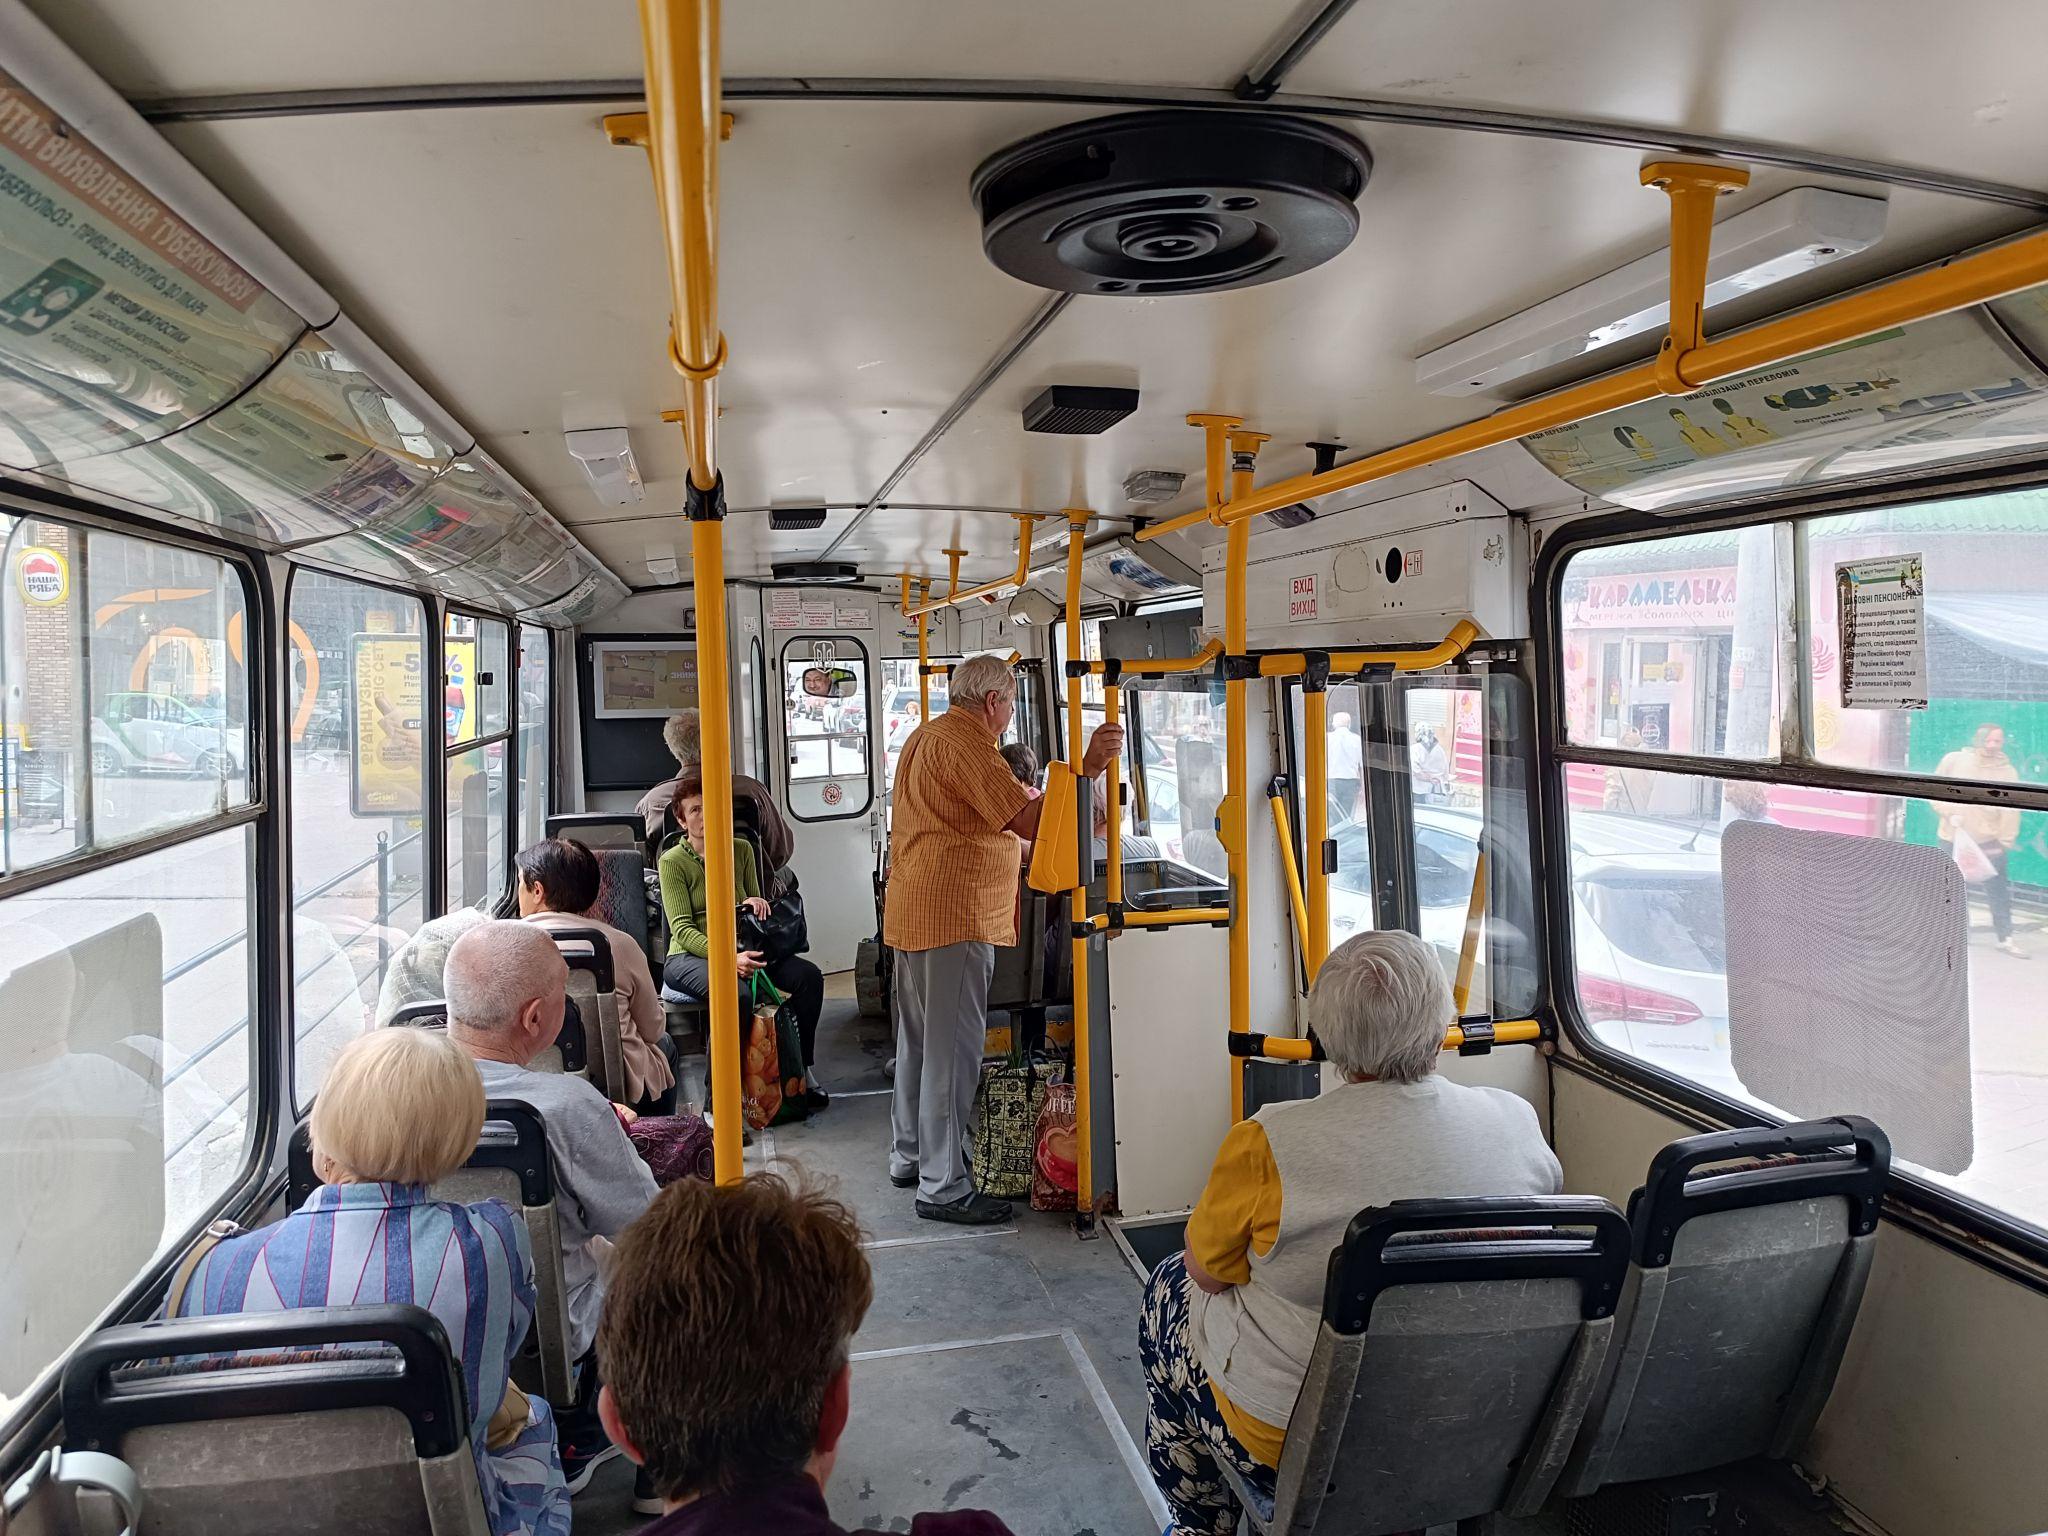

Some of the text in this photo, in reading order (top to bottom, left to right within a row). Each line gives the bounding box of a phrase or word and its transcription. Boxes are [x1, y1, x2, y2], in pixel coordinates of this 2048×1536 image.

[36, 134, 159, 231] ВИЯВЛЕННЯ
[151, 216, 258, 301] ТУБЕРКУЛЬОЗУ
[1747, 368, 1800, 387] ПЕРЕЛОМІВ
[1544, 422, 1580, 437] ПЕРЕЛОМІВ
[27, 576, 60, 584] НАША
[28, 584, 61, 593] РЯБА
[1293, 577, 1314, 595] ВХІД
[1589, 576, 1737, 610] КАРАМЕЛЬКА
[1291, 598, 1317, 616] ВИХІД
